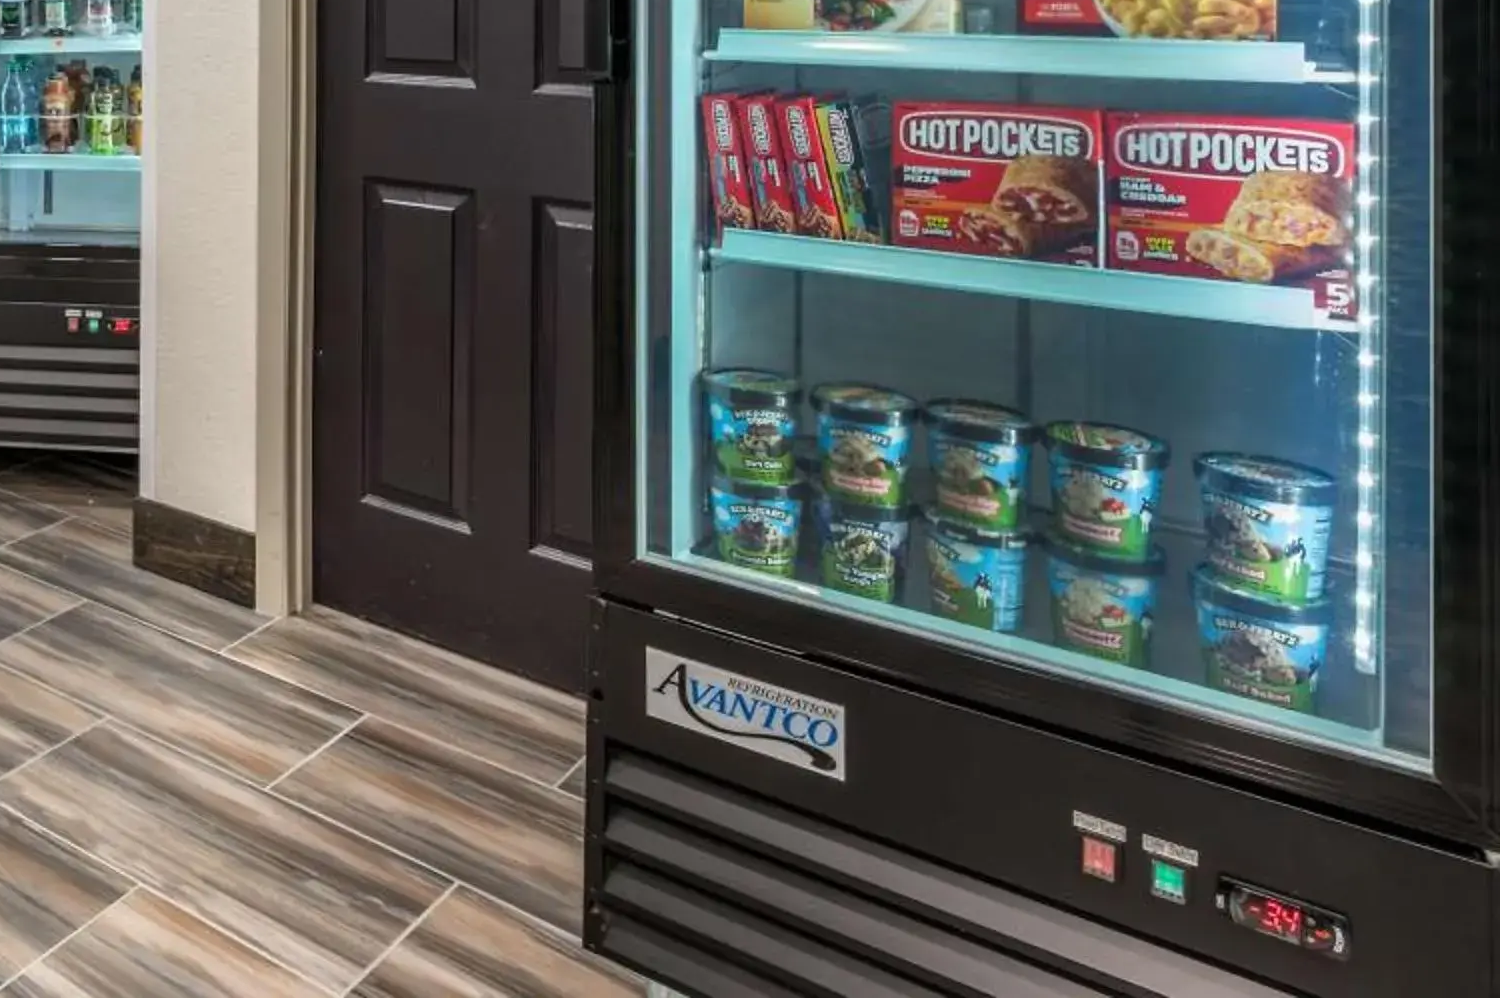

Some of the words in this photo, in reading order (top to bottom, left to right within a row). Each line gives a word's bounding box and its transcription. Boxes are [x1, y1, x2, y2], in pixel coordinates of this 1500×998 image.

[1326, 282, 1350, 306] 5
[653, 663, 839, 750] AVANTCO
[727, 677, 839, 719] REFRIGERATION
